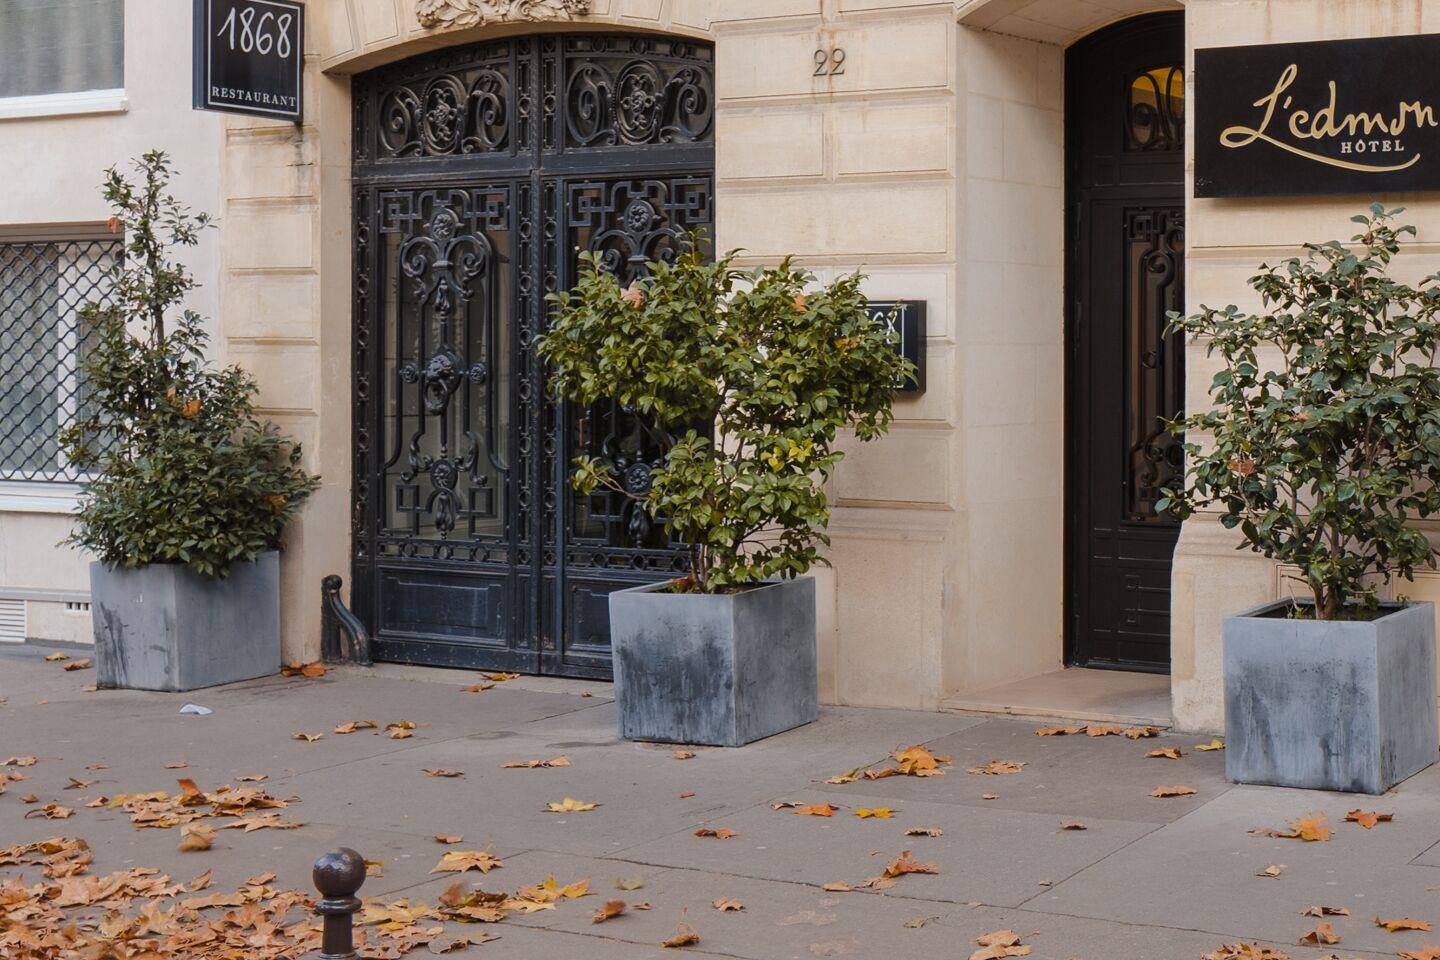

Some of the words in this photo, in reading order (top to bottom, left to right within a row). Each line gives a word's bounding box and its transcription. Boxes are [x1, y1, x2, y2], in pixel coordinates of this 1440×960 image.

[217, 6, 292, 58] 1868
[812, 48, 846, 76] 22
[211, 85, 297, 107] RESTAURANT
[1340, 139, 1405, 154] HÔTEL
